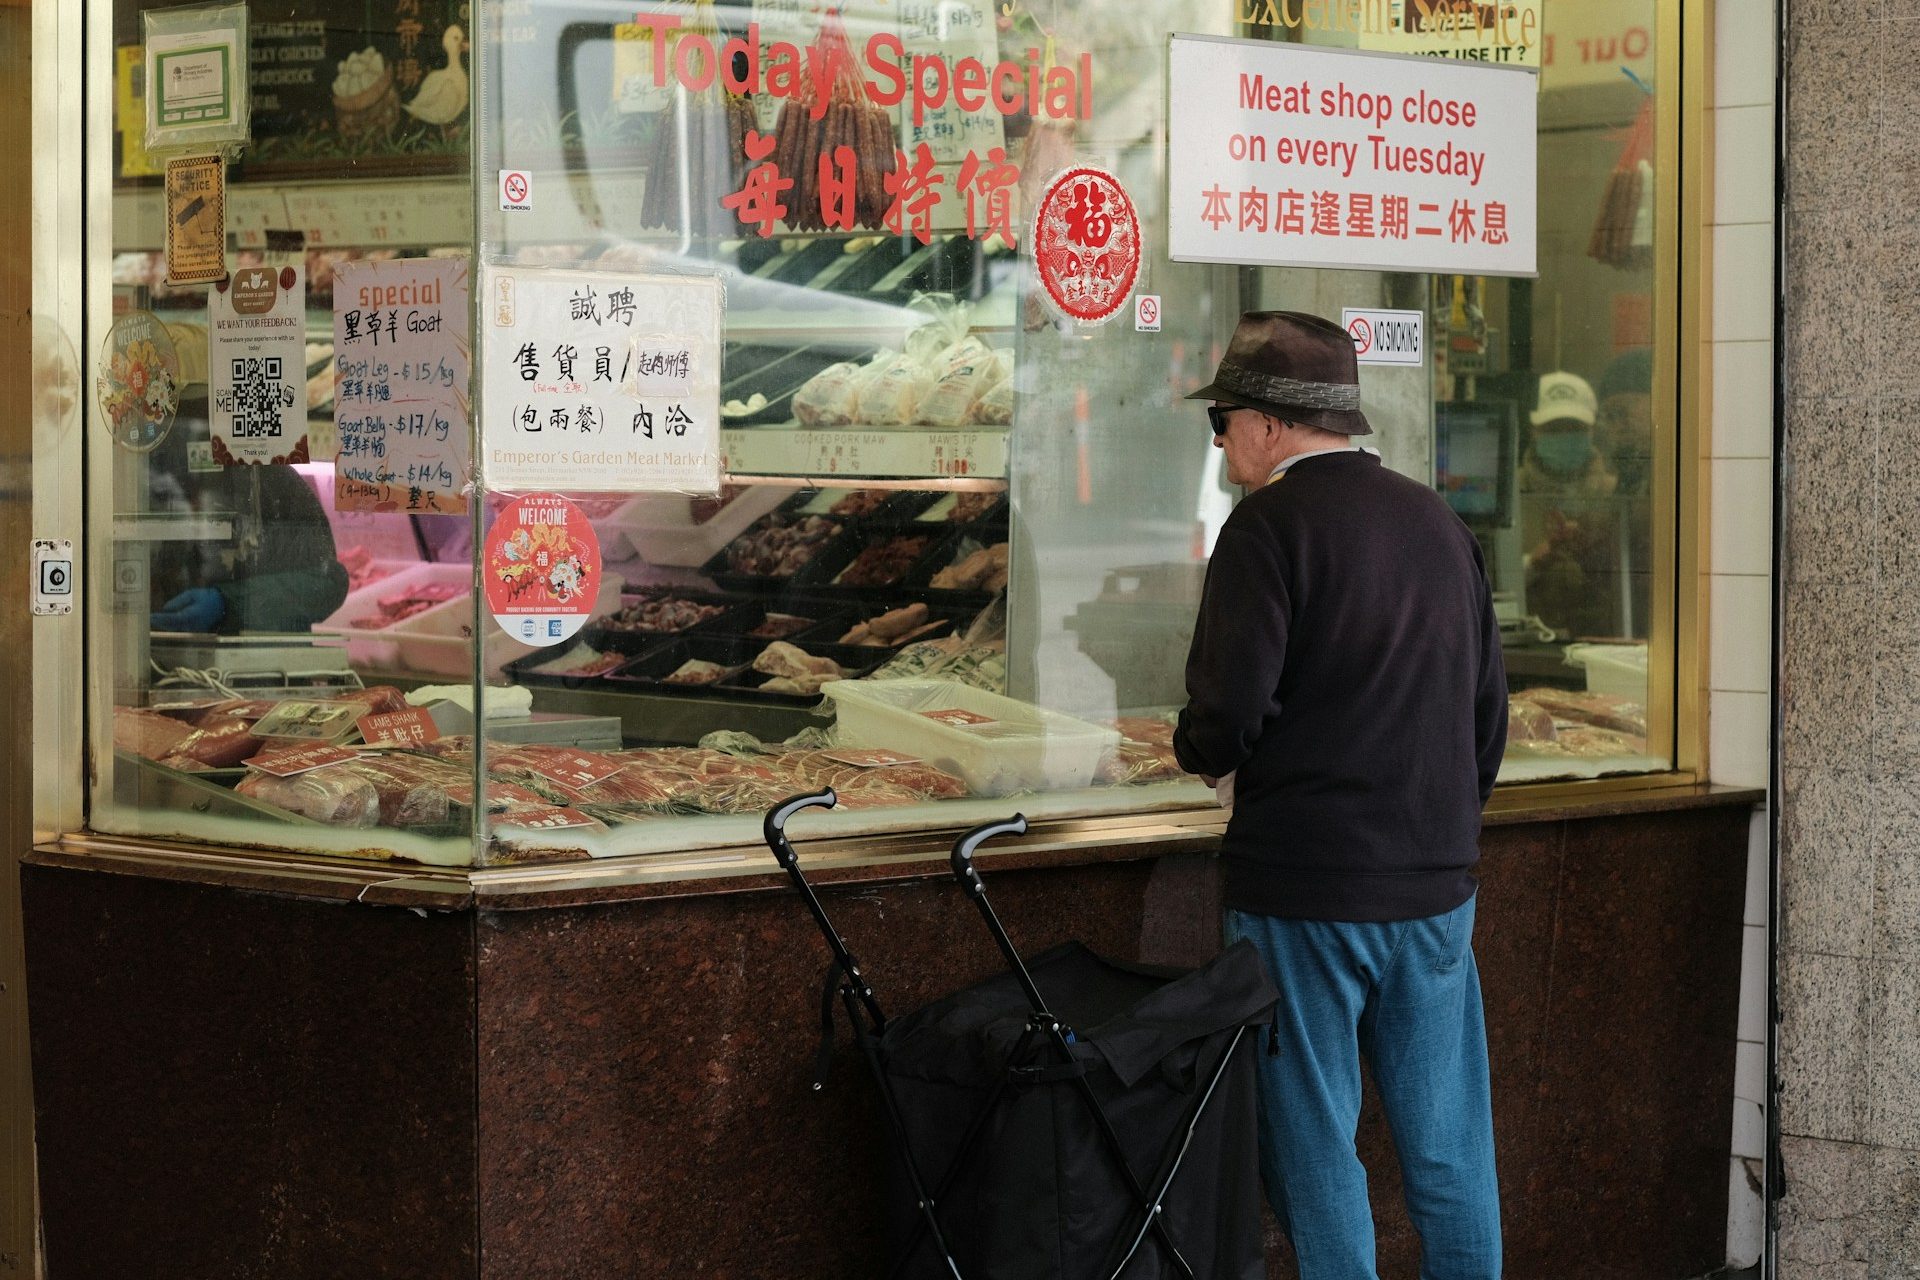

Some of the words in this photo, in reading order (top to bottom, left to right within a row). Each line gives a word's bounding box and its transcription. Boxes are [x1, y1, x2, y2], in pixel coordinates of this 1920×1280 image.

[1411, 0, 1535, 48] Service
[1495, 47, 1511, 62] IT
[637, 13, 840, 121] Today
[866, 32, 1092, 127] Special
[1239, 72, 1311, 115] Meat
[1320, 82, 1393, 129] shop
[1402, 90, 1476, 128] close
[1228, 133, 1266, 162] on
[1277, 139, 1358, 178] every
[1367, 135, 1485, 186] Tuesday
[176, 168, 214, 181] SECURITY
[181, 180, 210, 192] NOTICE
[722, 129, 1021, 249] 每日特價
[1065, 181, 1112, 248] 福
[1200, 183, 1509, 245] 本肉店逢星期二休息
[360, 278, 440, 312] special
[569, 284, 637, 327] 誠聘
[117, 322, 152, 346] WELCOME
[217, 320, 226, 329] WE
[227, 320, 243, 329] WANT
[245, 319, 260, 328] YOUR
[344, 309, 398, 346] 黑草羊
[406, 310, 443, 334] Goat
[1374, 321, 1384, 351] NO
[1386, 322, 1418, 352] SMOKING
[338, 354, 368, 378] Goat
[372, 356, 388, 383] Leg
[339, 413, 363, 436] Goat
[366, 416, 386, 440] Belly
[513, 404, 604, 434] (包兩餐)
[794, 433, 832, 444] COOKED
[834, 434, 859, 444] PORK
[863, 434, 886, 445] MAW
[963, 434, 976, 445] TIP
[494, 450, 568, 466] Emperor's
[573, 451, 622, 464] Garden
[628, 452, 659, 465] Meat
[664, 452, 708, 466] Market
[344, 465, 374, 483] Whole
[519, 507, 568, 526] WELCOME
[536, 550, 548, 566] 福
[368, 716, 392, 730] LAMB
[392, 712, 420, 726] SHANK
